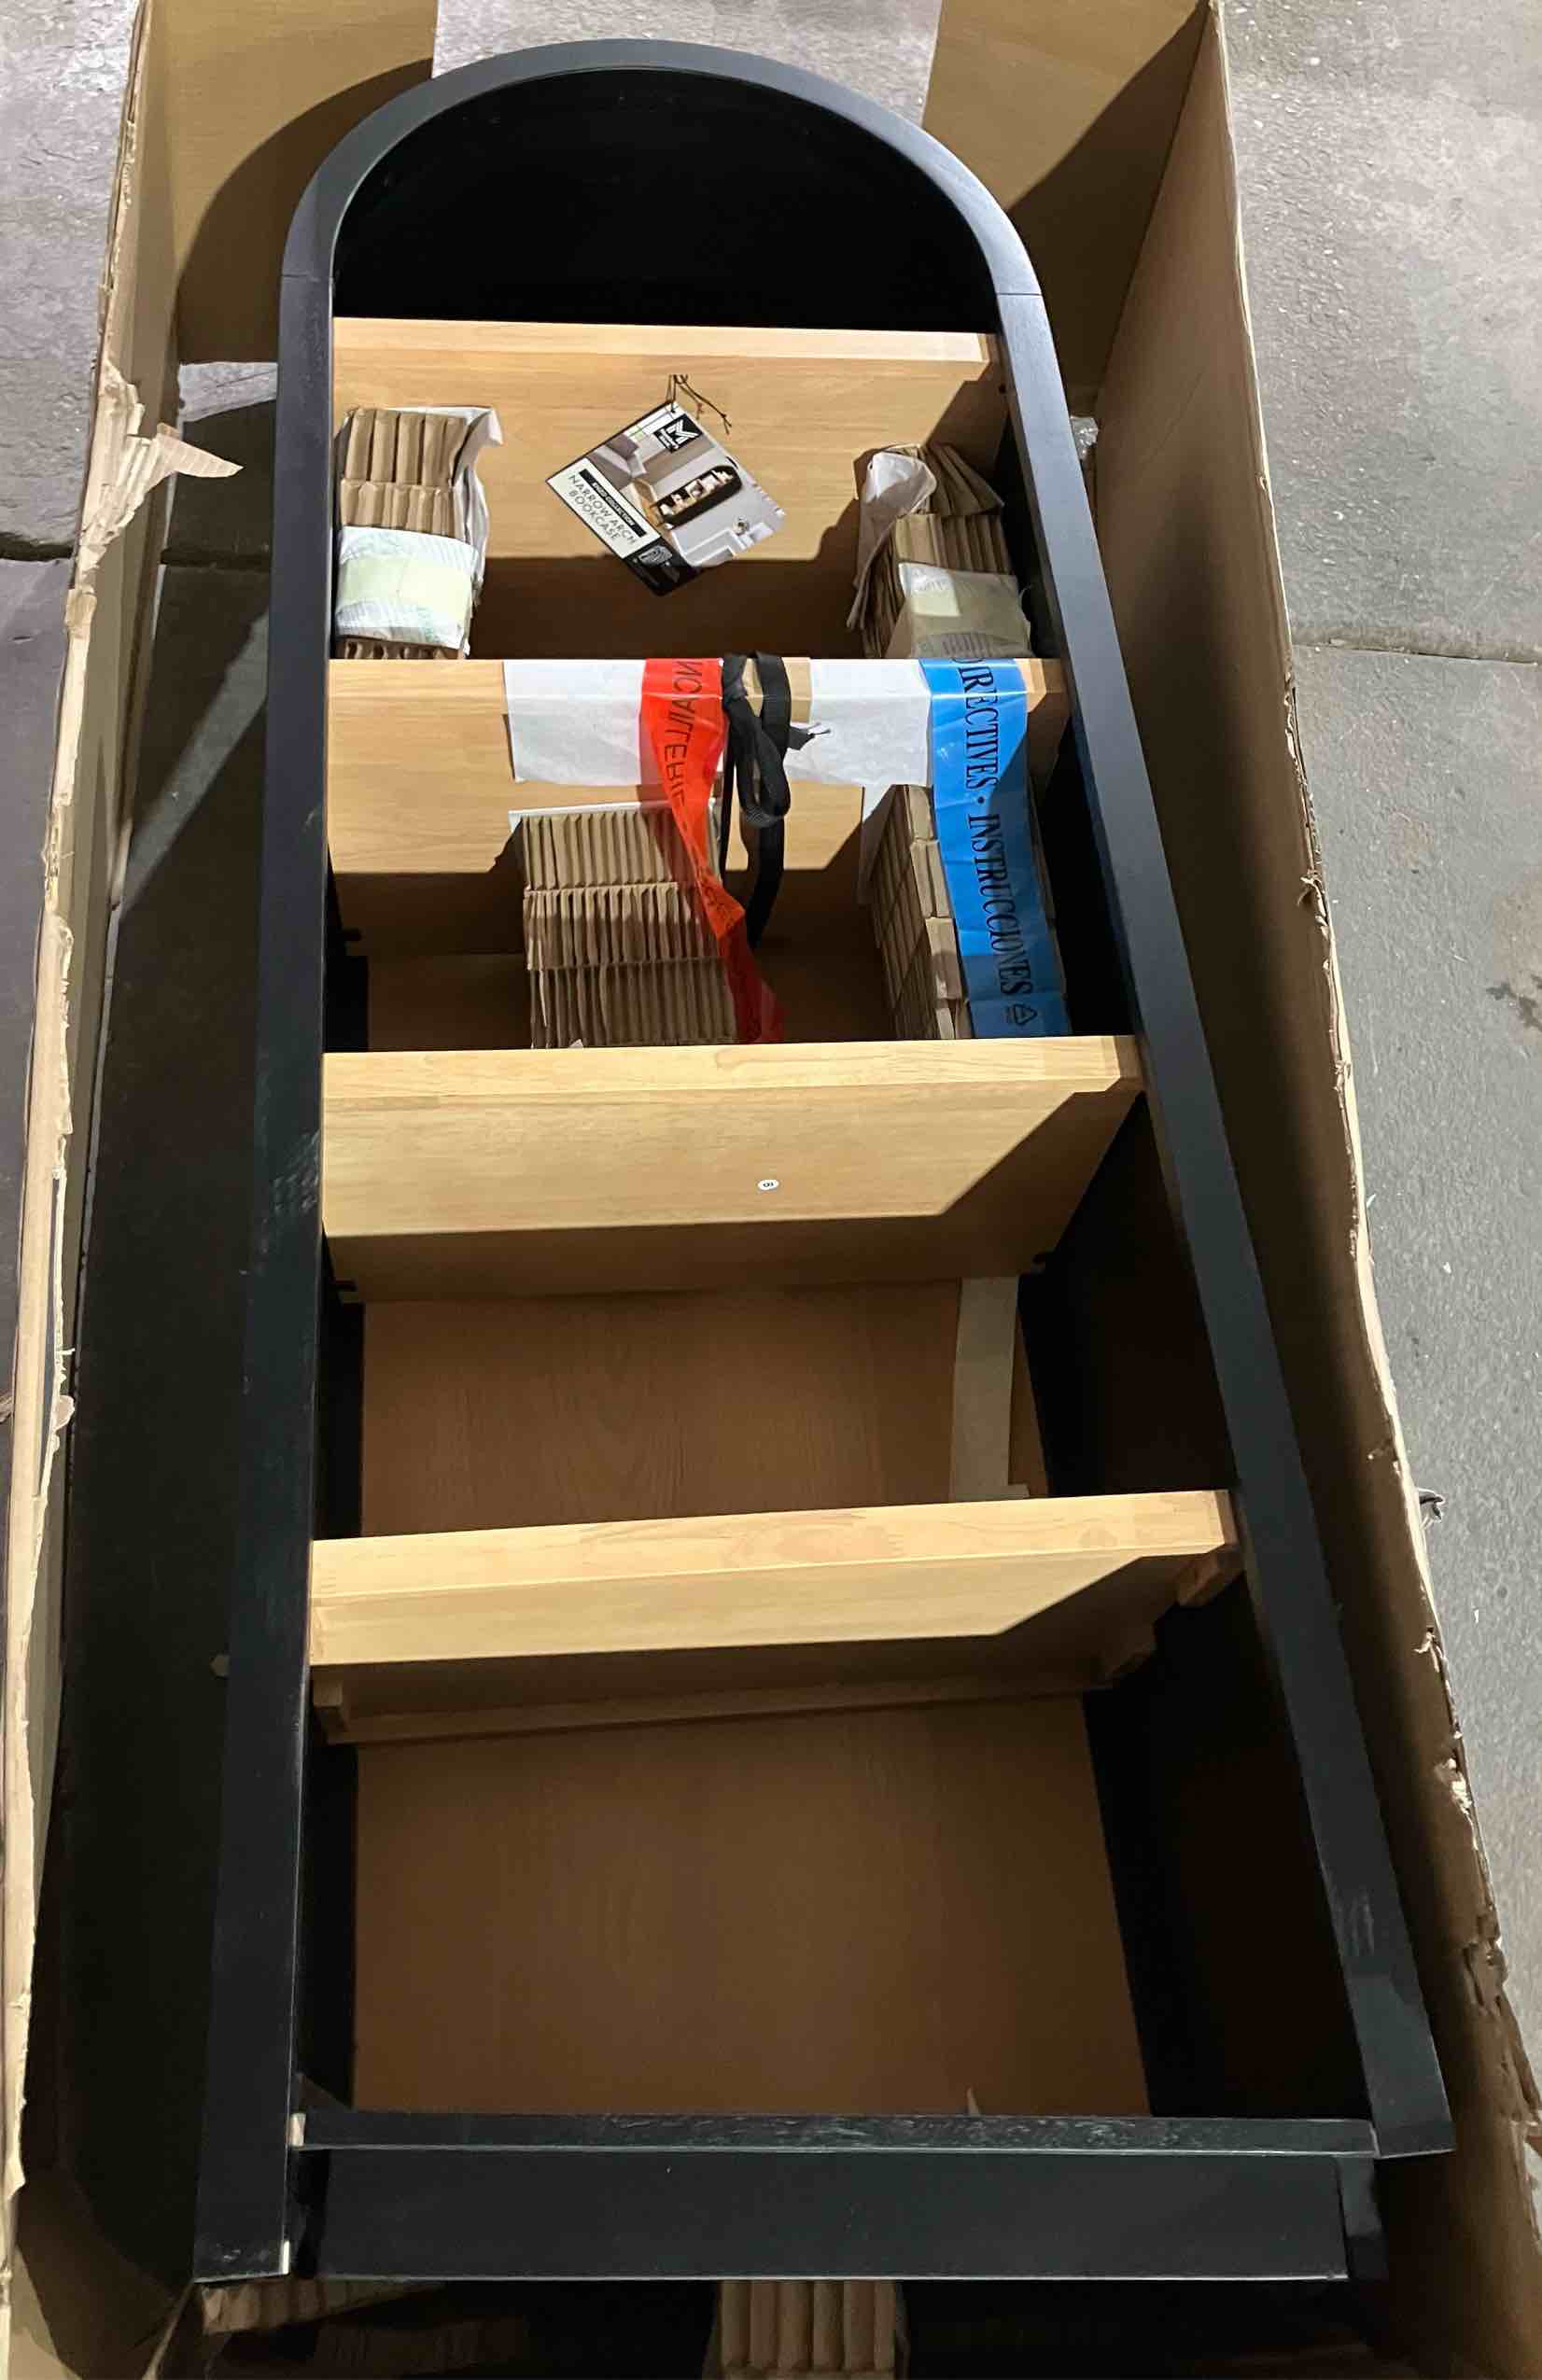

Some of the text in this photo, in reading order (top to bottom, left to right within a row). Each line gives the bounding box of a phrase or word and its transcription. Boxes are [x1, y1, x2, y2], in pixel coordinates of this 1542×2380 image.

[568, 474, 638, 544] NARROW ARCH
[568, 490, 620, 539] BOOKCASE
[967, 813, 1034, 996] INSTRUCCIONES
